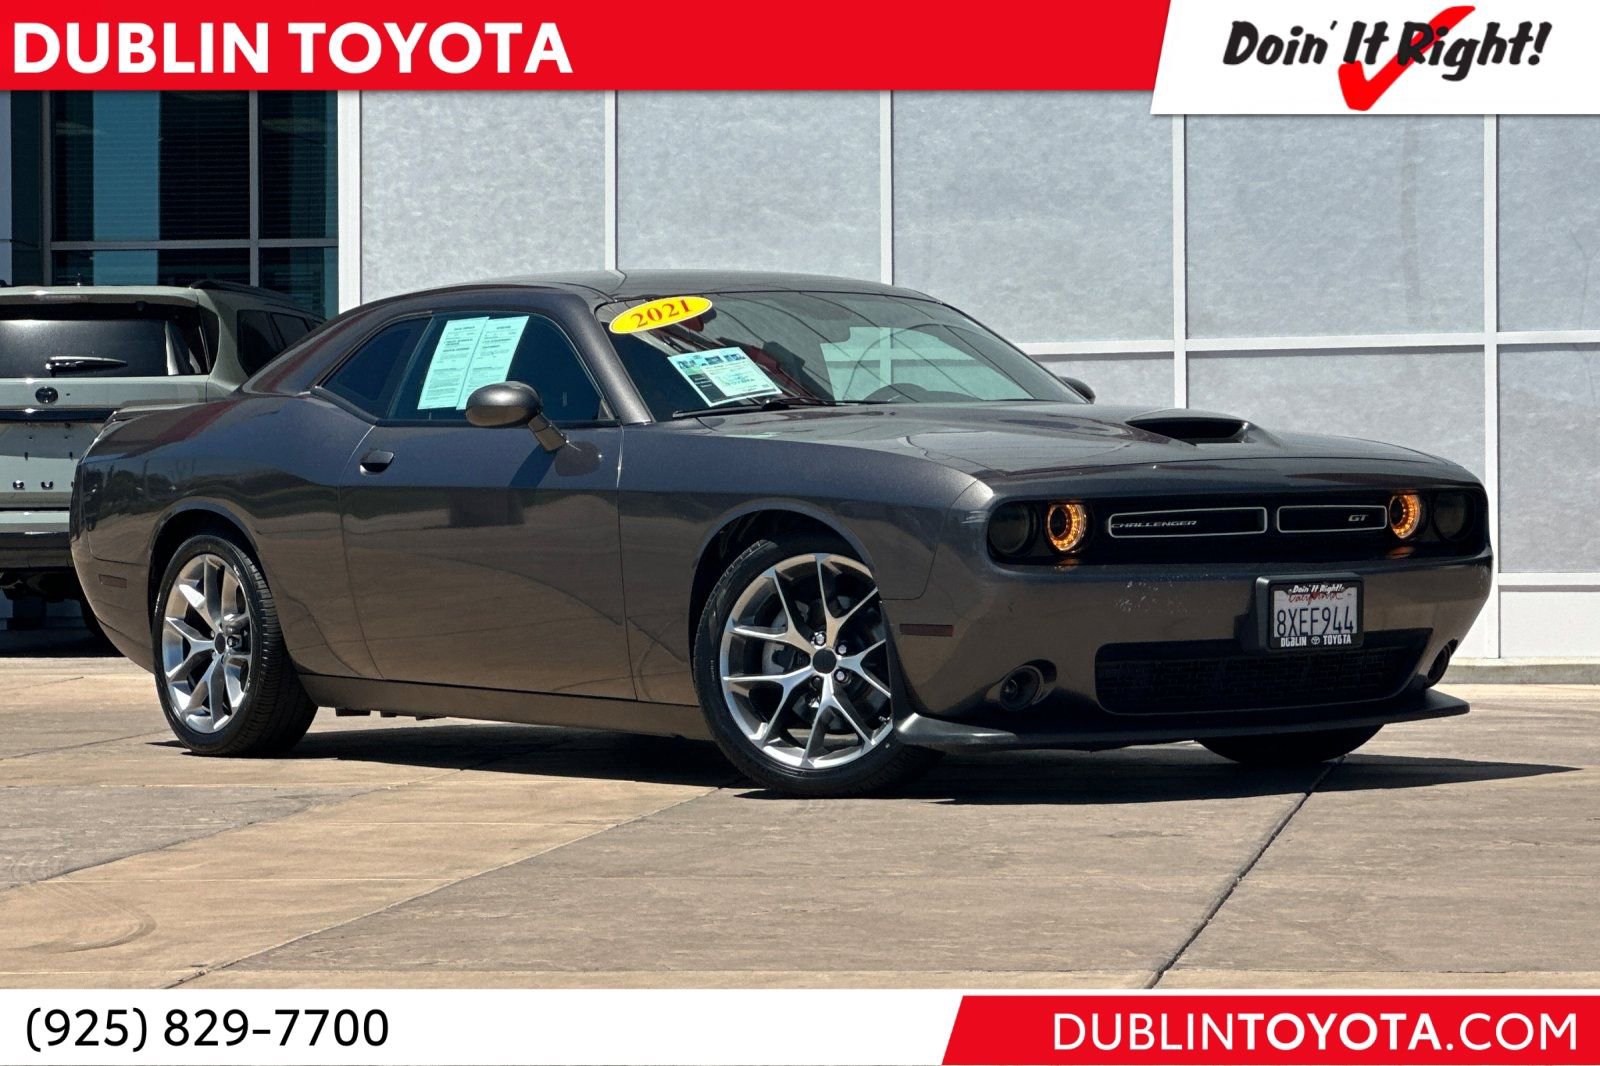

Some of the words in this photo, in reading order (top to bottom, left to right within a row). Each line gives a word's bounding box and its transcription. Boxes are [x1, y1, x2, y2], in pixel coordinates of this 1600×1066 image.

[631, 299, 692, 329] 2021
[1110, 520, 1198, 529] CHALLENGER
[1348, 514, 1369, 522] GT
[1276, 605, 1354, 637] 8XEF944
